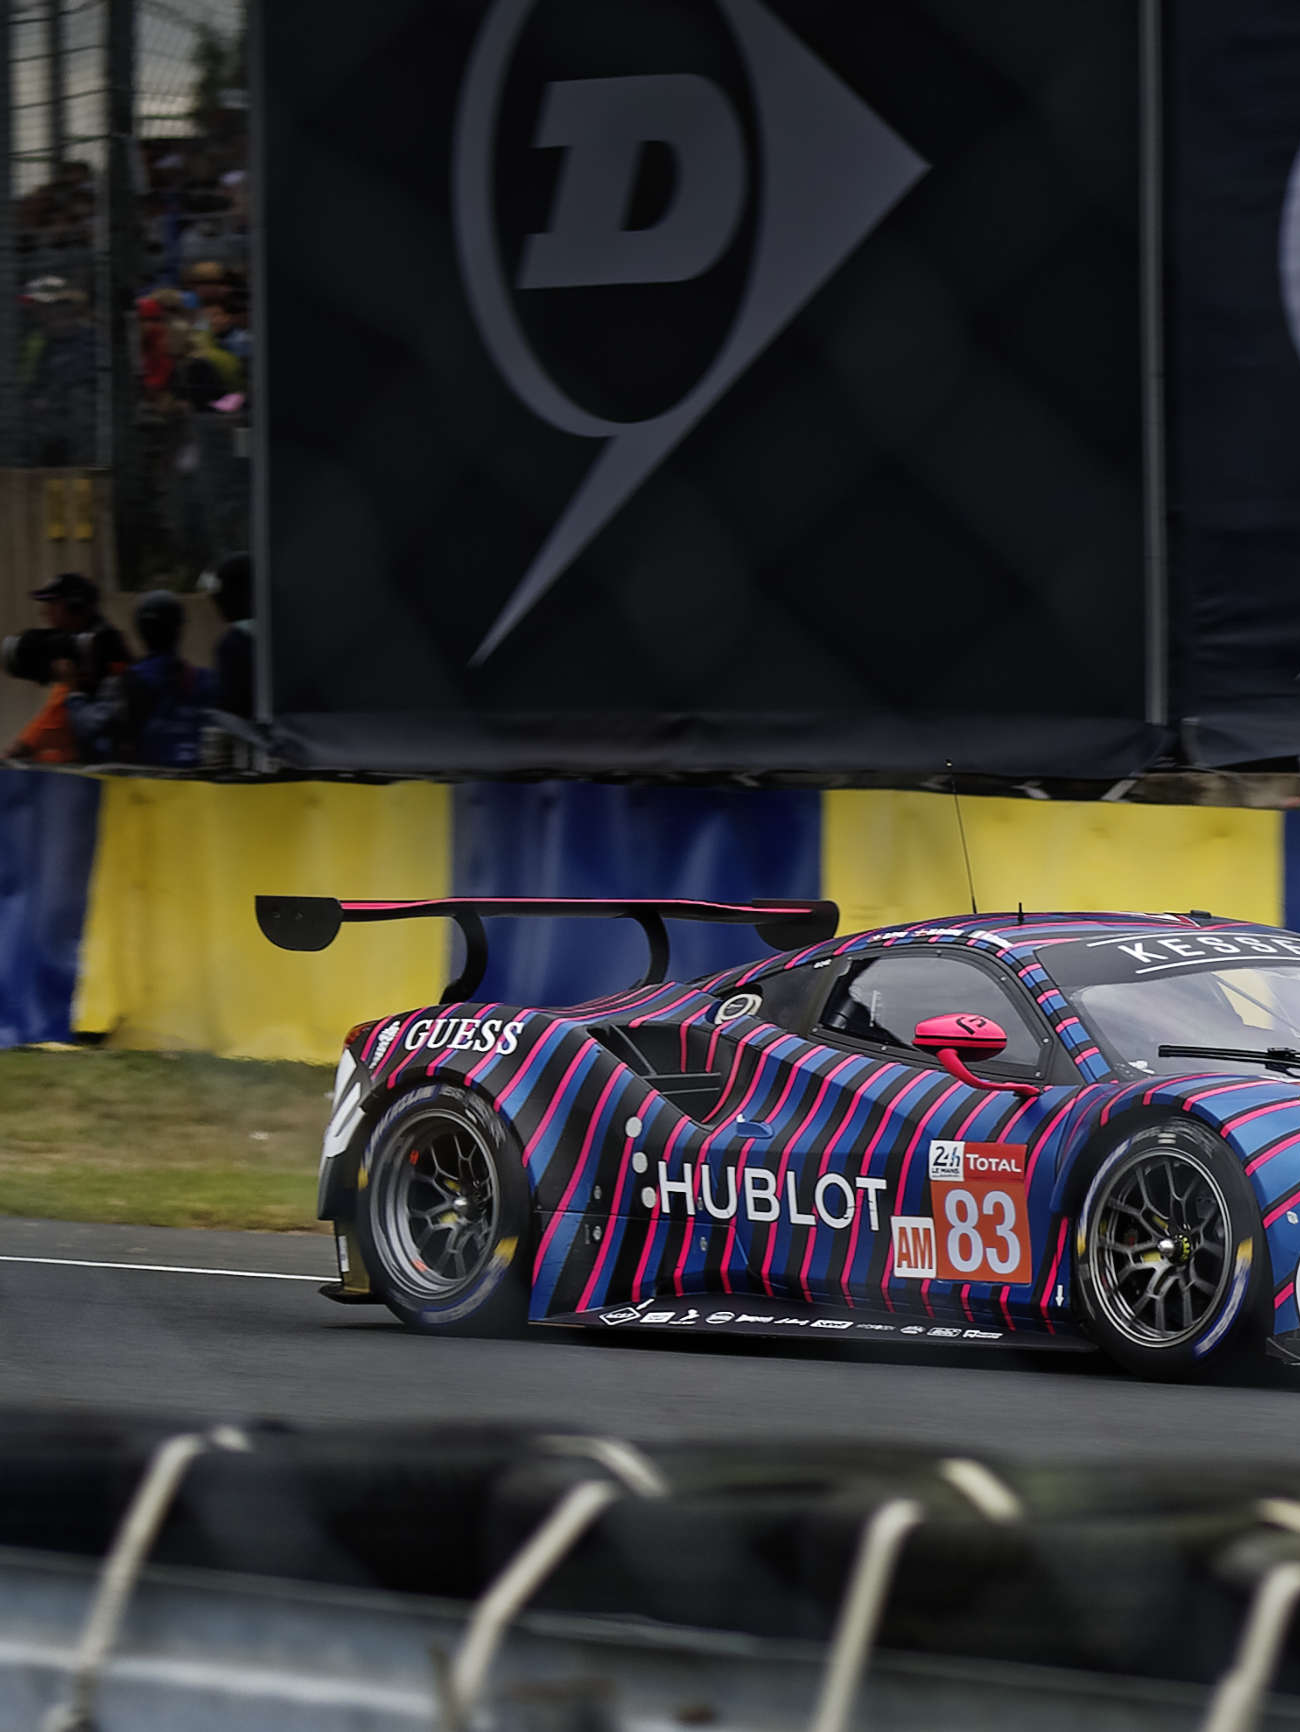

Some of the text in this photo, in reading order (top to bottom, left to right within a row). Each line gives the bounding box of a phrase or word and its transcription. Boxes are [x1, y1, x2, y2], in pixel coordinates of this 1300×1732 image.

[517, 73, 747, 290] D
[404, 1018, 525, 1056] GUESS
[966, 1153, 1022, 1173] TOTAL
[657, 1160, 888, 1231] HUBLOT
[896, 1226, 933, 1269] AM
[945, 1189, 1021, 1274] 83
